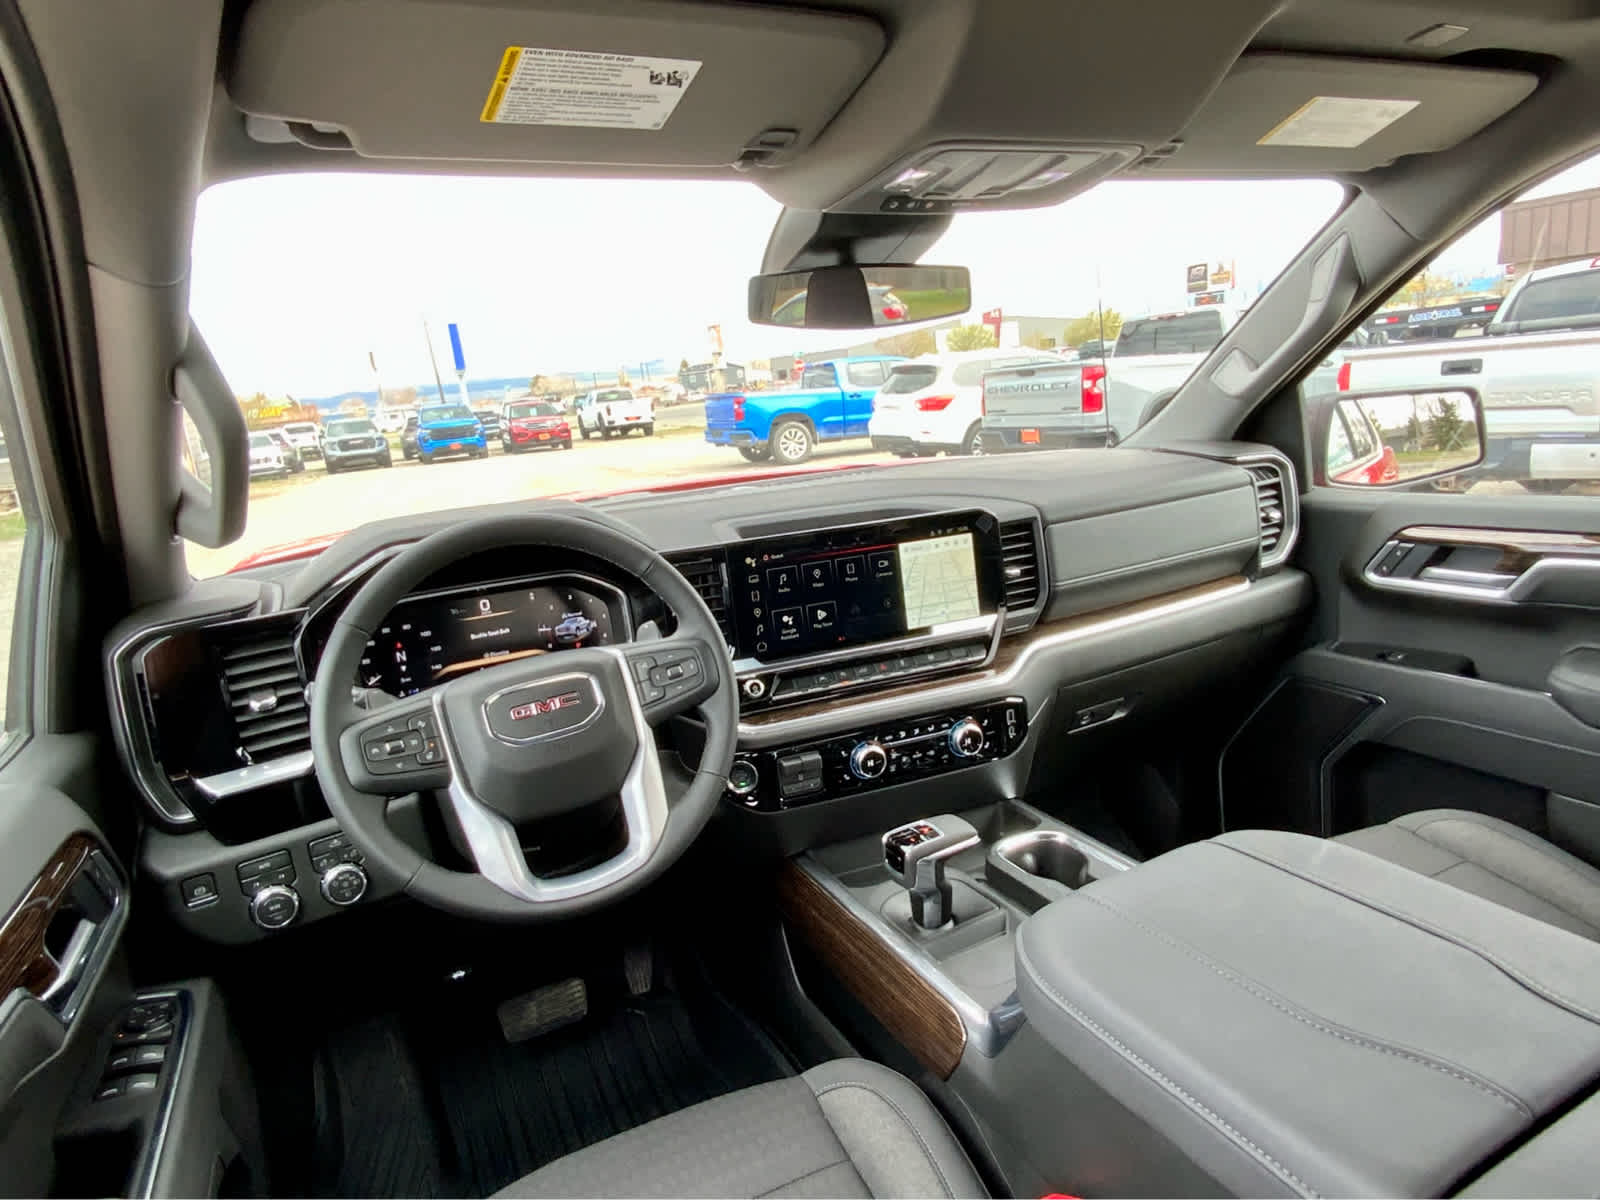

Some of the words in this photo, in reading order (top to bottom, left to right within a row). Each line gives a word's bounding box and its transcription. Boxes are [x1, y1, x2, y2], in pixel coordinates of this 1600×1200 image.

[987, 382, 1070, 394] CHEVROLET
[479, 599, 491, 612] 0
[510, 691, 581, 721] GMC
